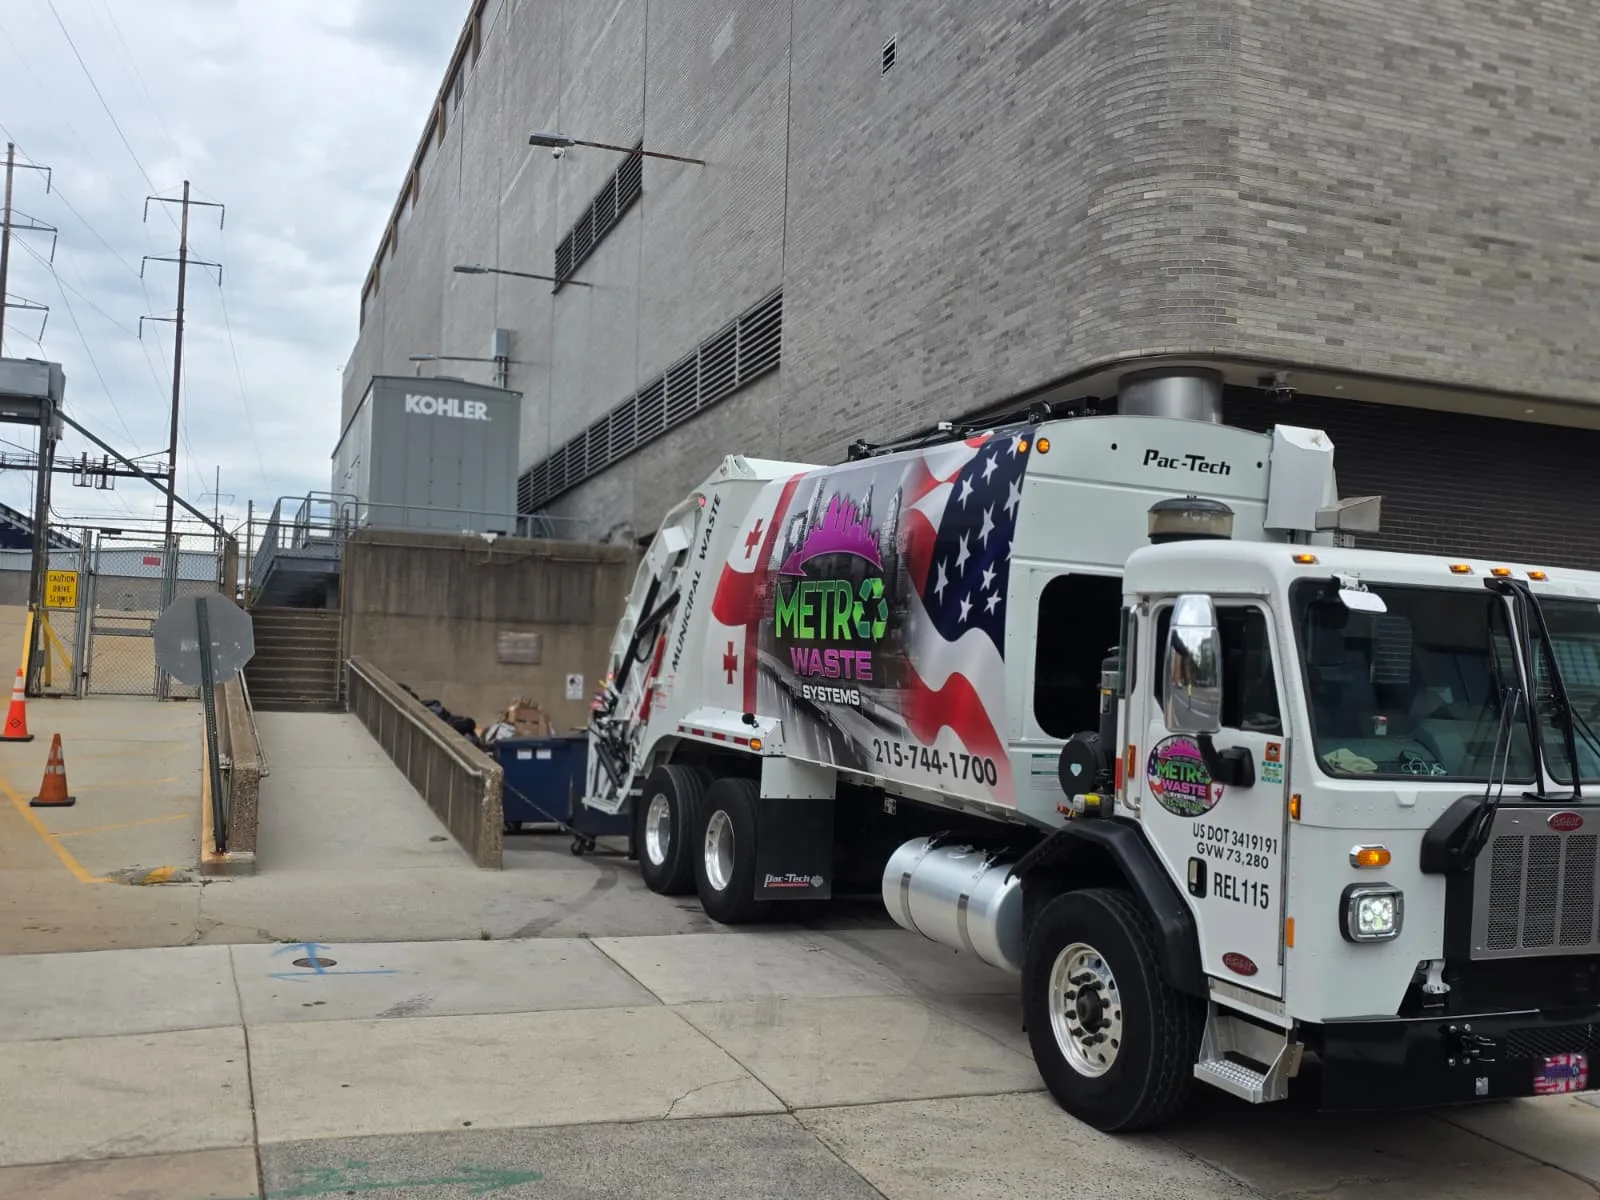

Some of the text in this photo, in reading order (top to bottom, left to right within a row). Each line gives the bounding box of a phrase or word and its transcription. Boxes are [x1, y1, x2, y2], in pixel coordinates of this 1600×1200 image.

[405, 393, 488, 421] KOHLER
[1143, 449, 1231, 475] Pac-Tech
[49, 575, 75, 583] CAUTION
[671, 494, 721, 672] MUNICIPAL WASTE
[775, 578, 889, 641] METRO
[790, 647, 873, 680] WASTE
[802, 684, 860, 705] SYSTEMS
[873, 738, 997, 786] 215-744-1700
[1162, 778, 1206, 797] WASTE
[1196, 842, 1269, 869] GVW 73,280
[1231, 830, 1277, 855] 3419191
[763, 873, 810, 888] Pac-Tech
[1214, 872, 1269, 909] REL115
